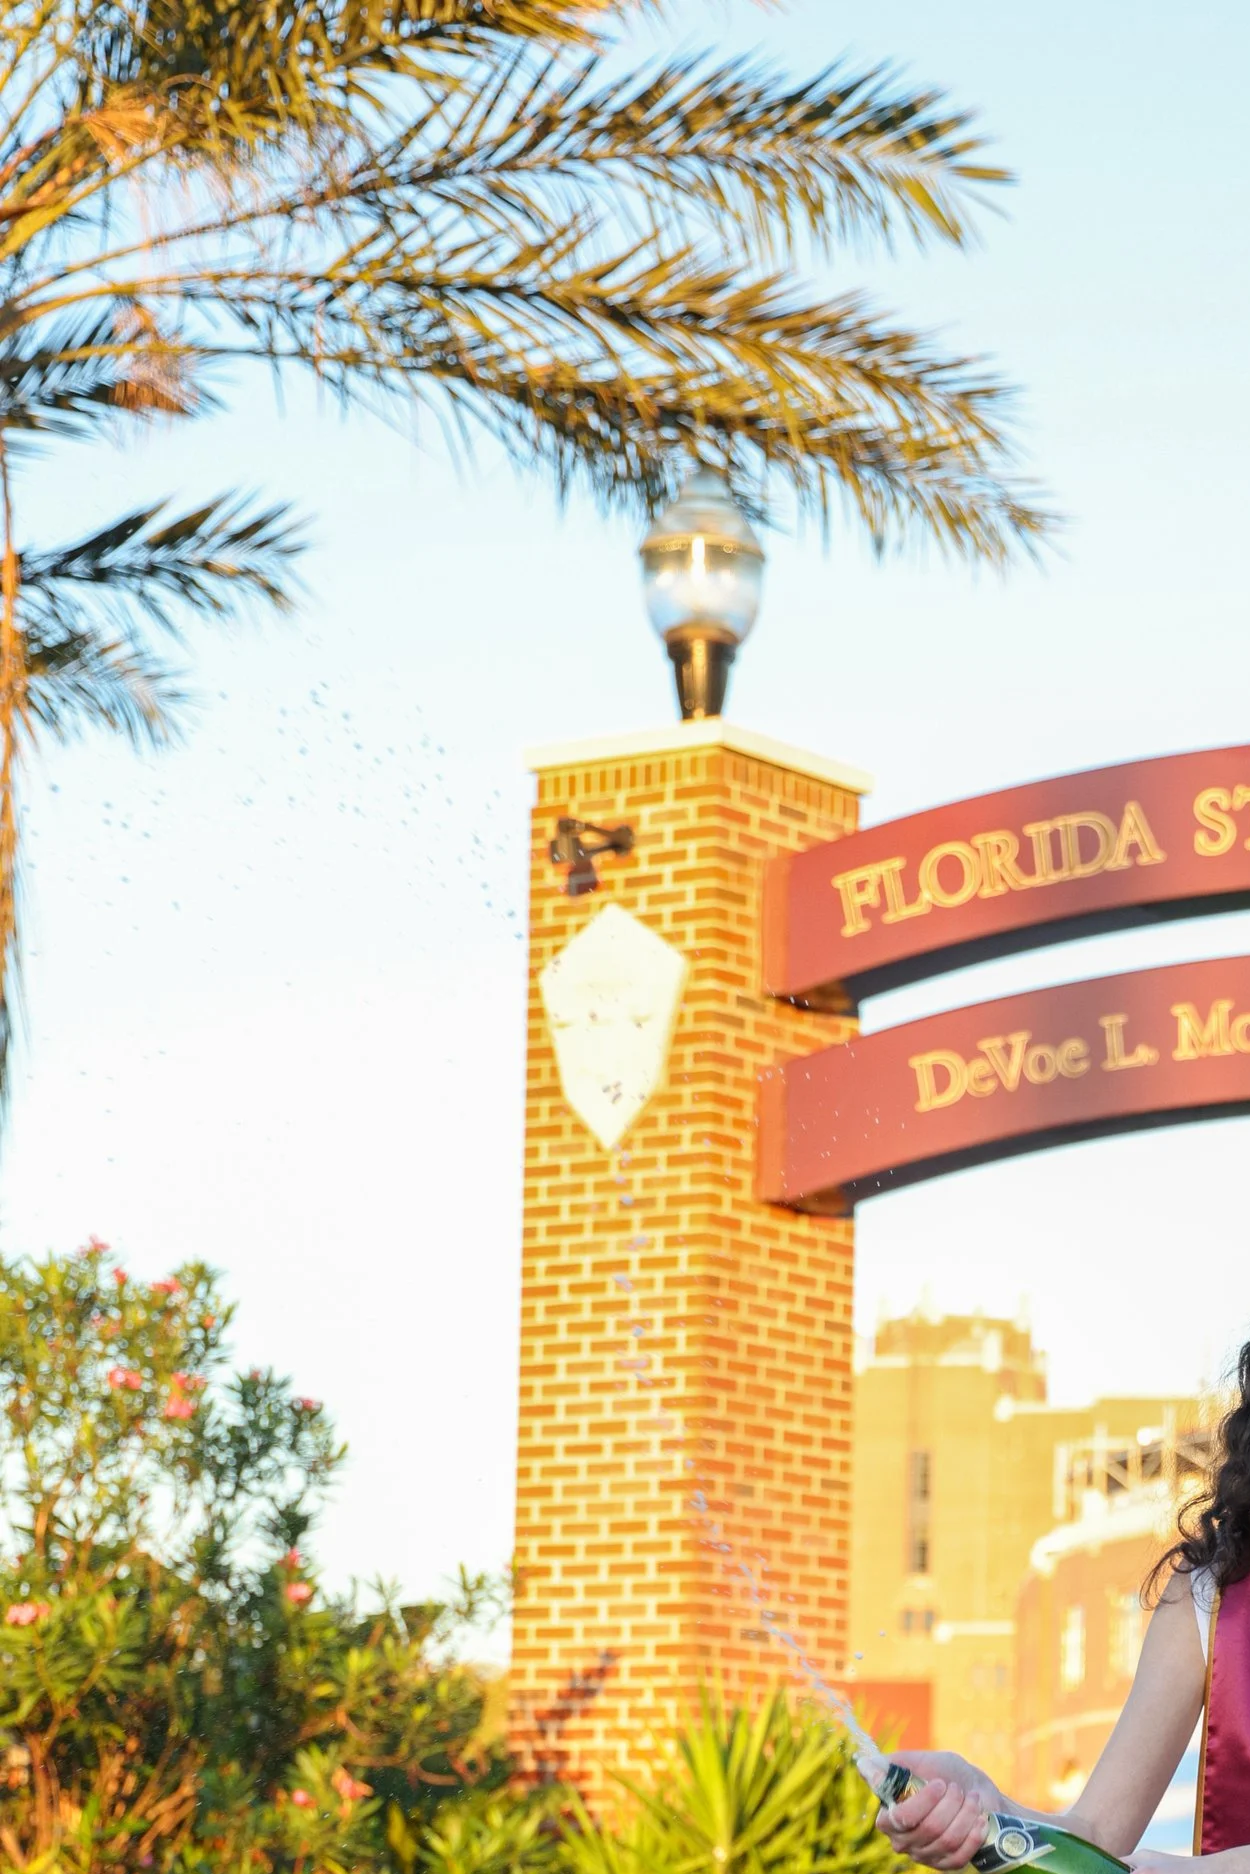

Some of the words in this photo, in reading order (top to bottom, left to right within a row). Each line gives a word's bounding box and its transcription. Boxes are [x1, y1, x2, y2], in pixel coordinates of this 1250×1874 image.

[832, 802, 1165, 937] FLORIDA
[910, 1032, 1091, 1112] DeVoe
[1100, 1014, 1158, 1071] L.
